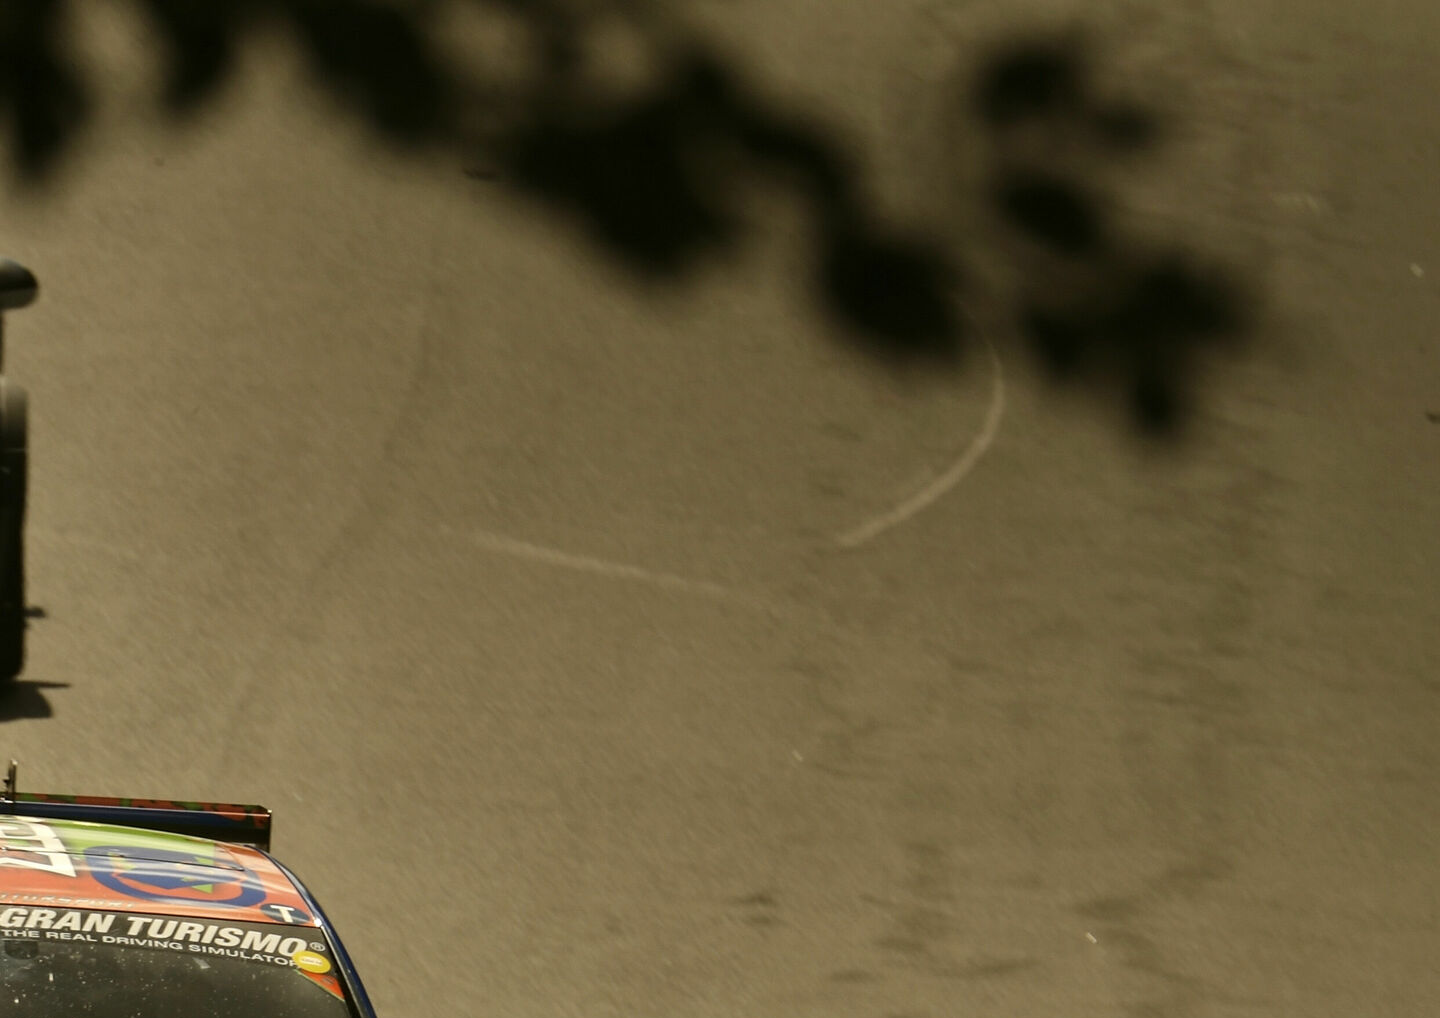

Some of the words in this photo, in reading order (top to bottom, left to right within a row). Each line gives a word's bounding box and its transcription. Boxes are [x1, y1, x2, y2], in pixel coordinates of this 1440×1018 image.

[1, 929, 40, 939] THE
[46, 931, 98, 943] REAL
[103, 936, 183, 951] DRIVING
[127, 916, 308, 958] TURISMO
